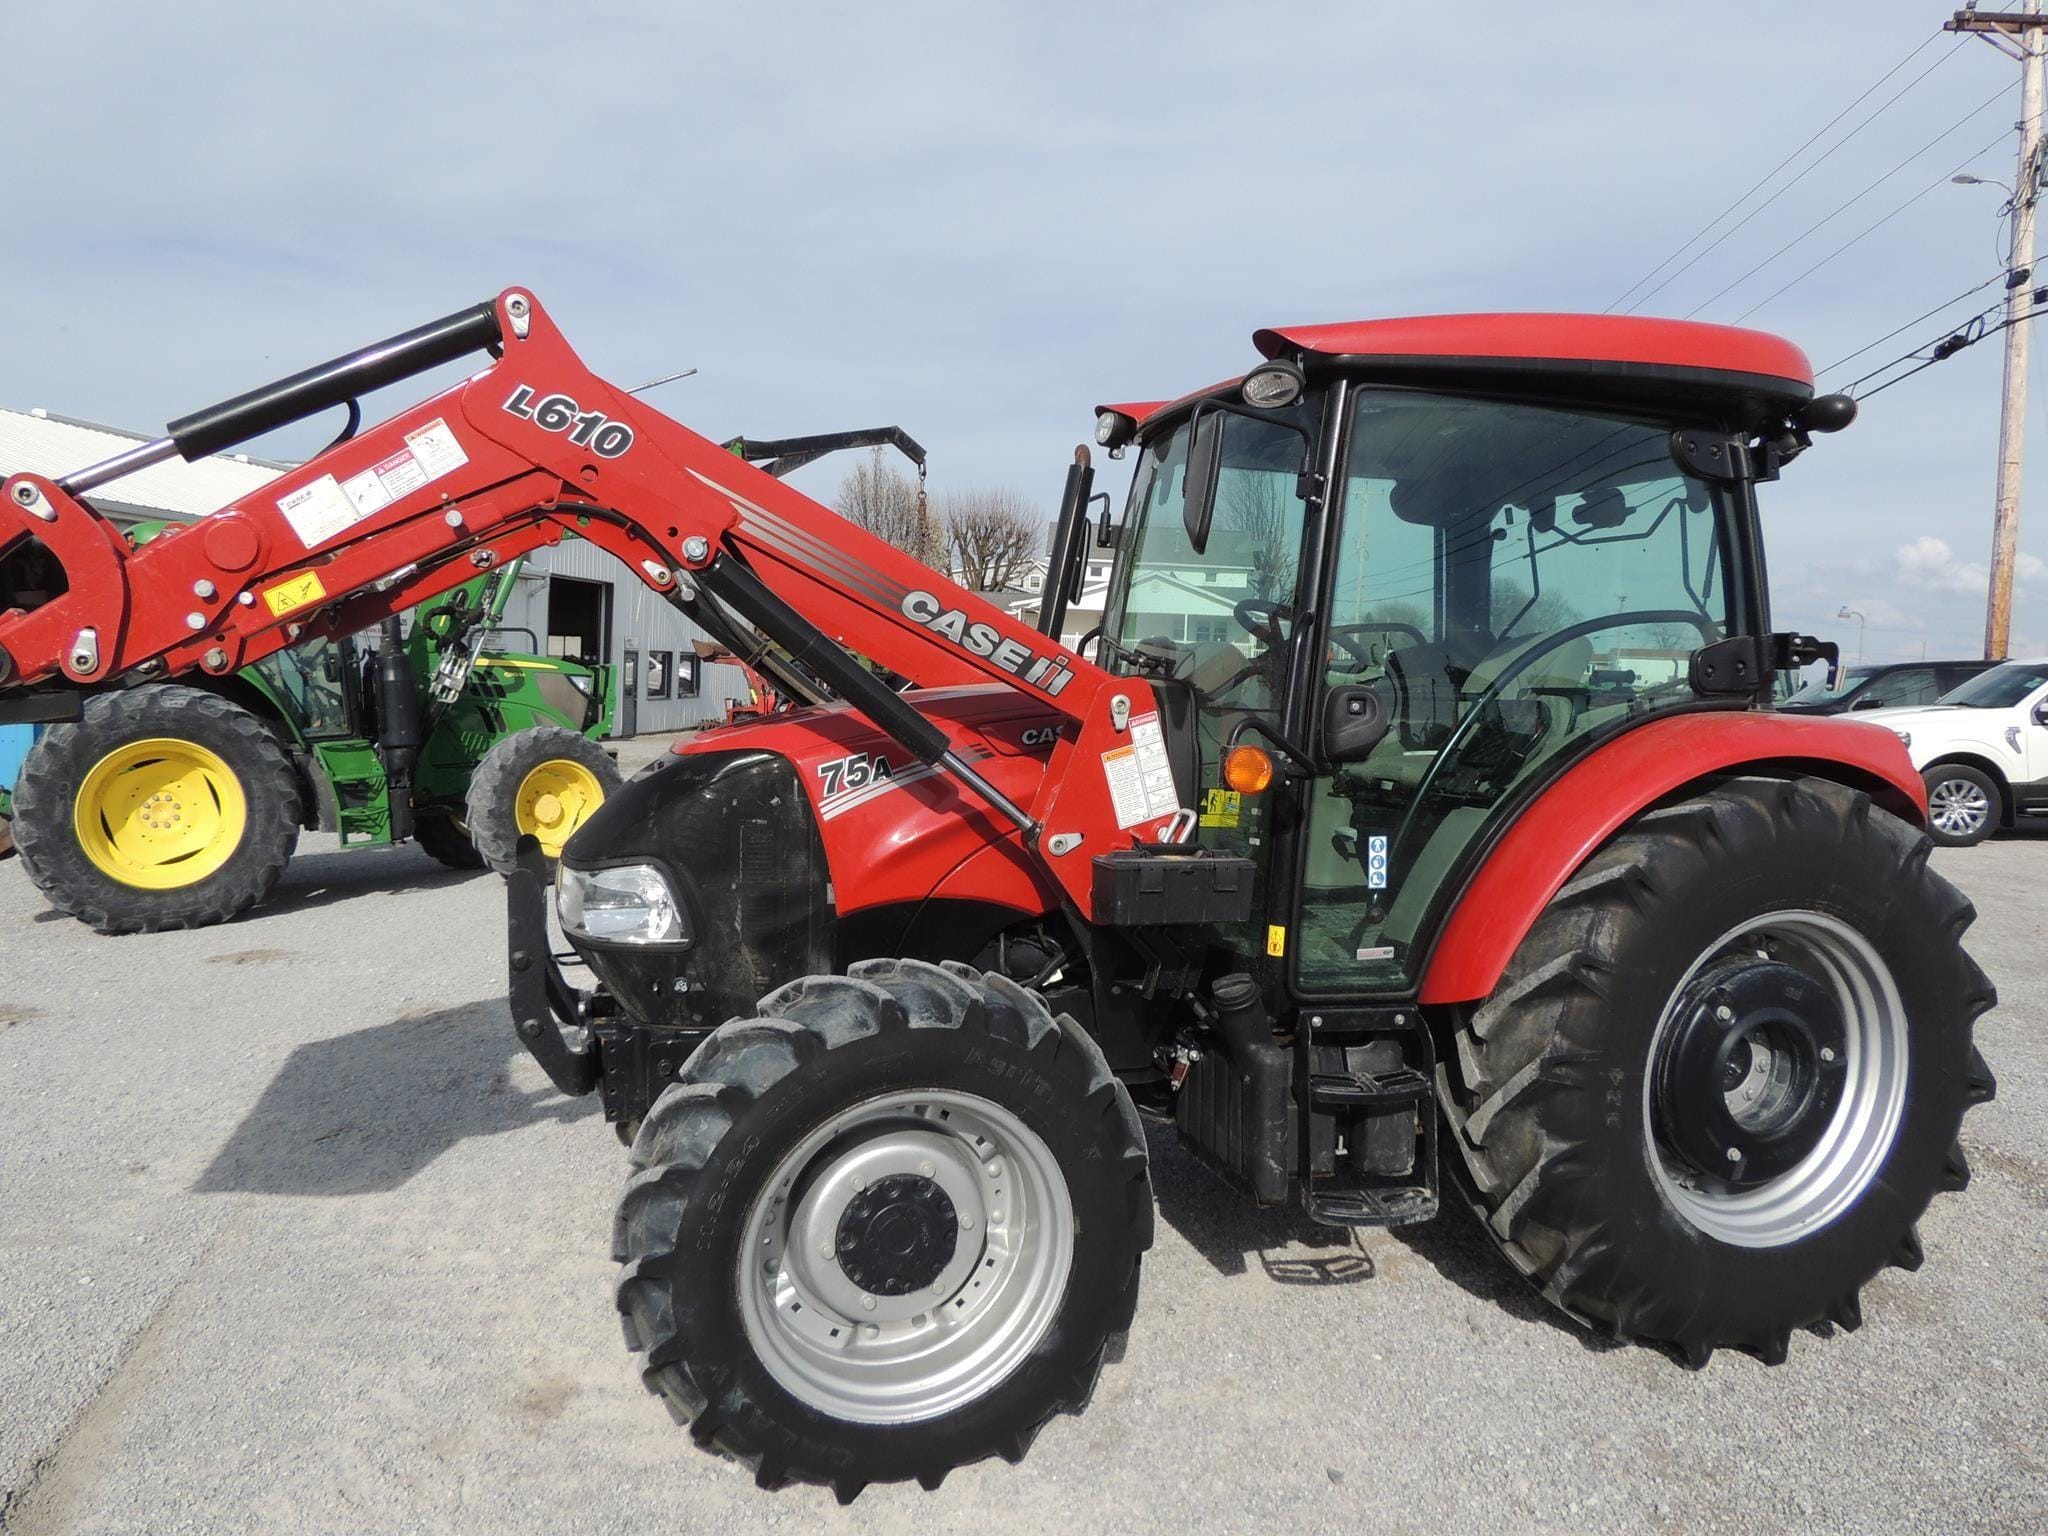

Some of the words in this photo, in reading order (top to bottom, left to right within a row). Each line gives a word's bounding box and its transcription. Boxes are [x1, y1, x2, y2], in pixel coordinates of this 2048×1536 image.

[502, 384, 634, 459] L610
[901, 590, 1033, 673] CASE
[817, 752, 896, 797] 75A
